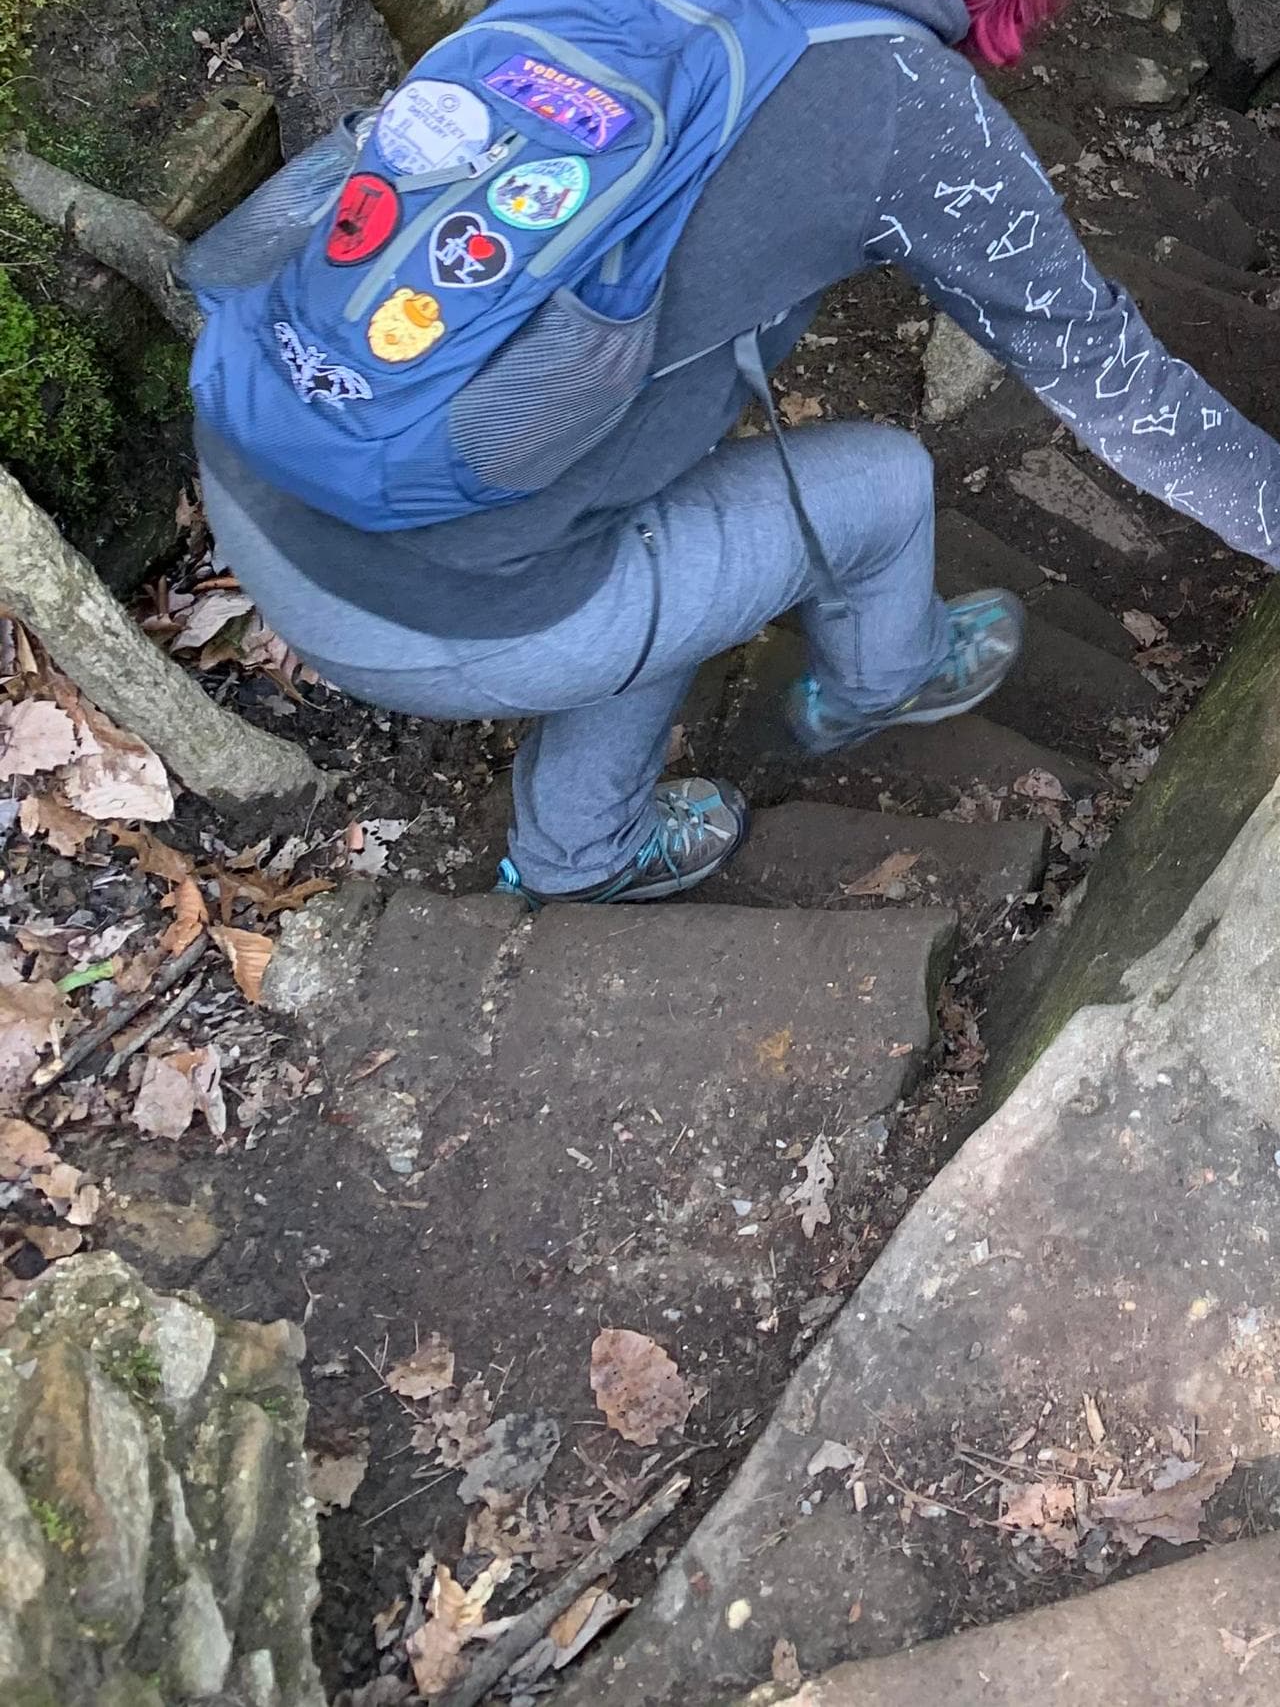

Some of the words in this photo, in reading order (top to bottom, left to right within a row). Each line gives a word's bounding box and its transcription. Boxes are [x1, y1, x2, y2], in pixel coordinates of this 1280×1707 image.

[523, 59, 585, 89] FOREST
[585, 87, 625, 117] WITCH
[407, 87, 438, 118] CASTLE
[445, 119, 466, 139] KEY
[408, 105, 449, 138] DISTILLERY
[435, 238, 486, 283] NY
